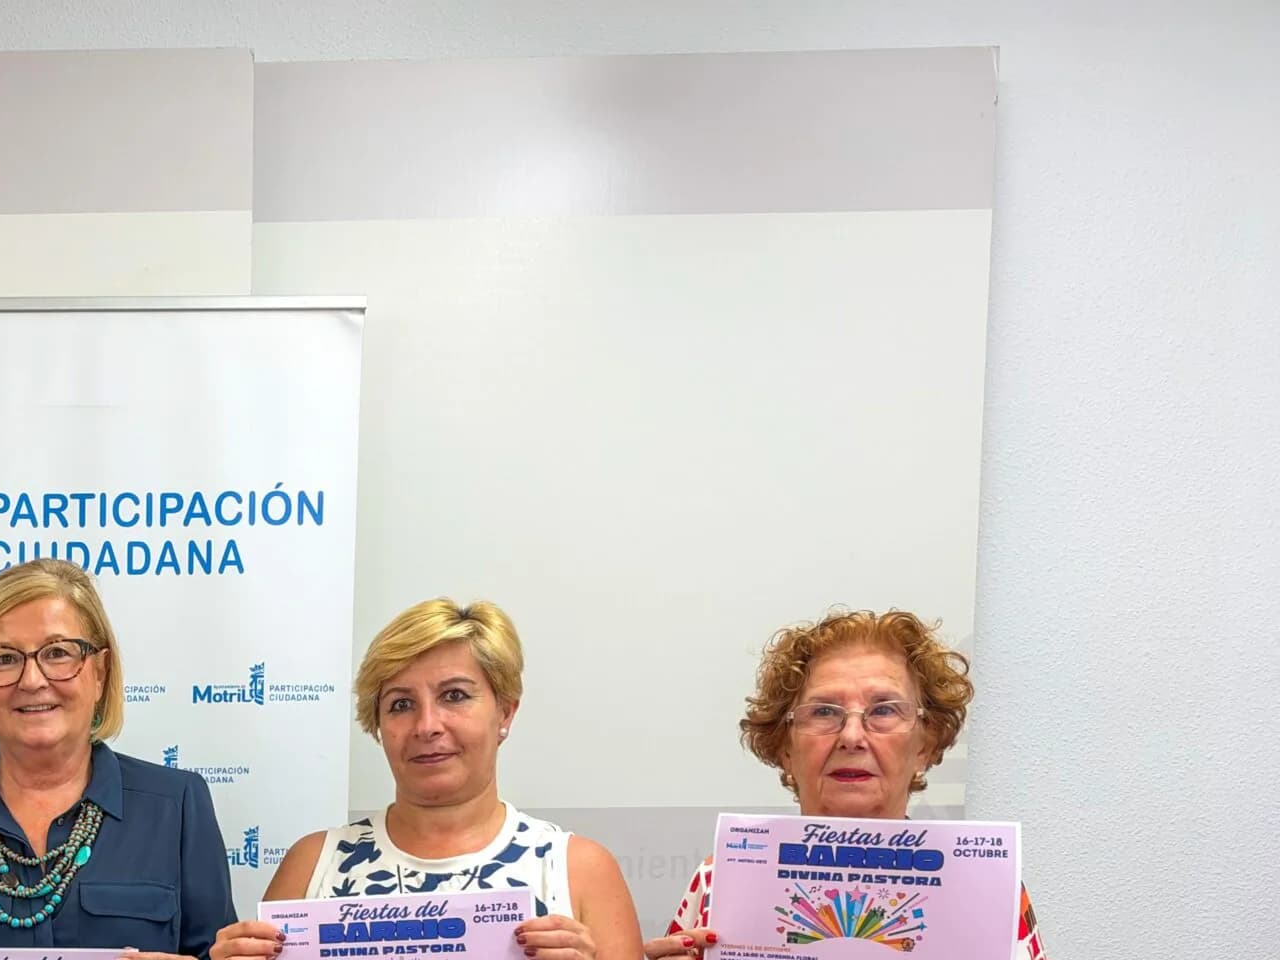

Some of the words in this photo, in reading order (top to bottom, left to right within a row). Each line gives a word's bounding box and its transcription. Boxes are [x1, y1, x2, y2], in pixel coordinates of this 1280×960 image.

[269, 684, 335, 693] PARTICIPACIÓN
[269, 694, 320, 702] CIUDADANA
[801, 824, 884, 846] Fiestas
[888, 830, 928, 847] del
[956, 837, 1002, 846] 16-17-18
[778, 843, 944, 872] BARRIO
[953, 848, 1008, 858] OCTUBRE
[777, 869, 844, 882] DIVINA
[848, 873, 941, 886] PASTORA
[339, 903, 411, 922] Fiestas
[414, 900, 448, 918] del
[475, 903, 518, 912] 16-17-18
[473, 913, 523, 923] OCTUBRE
[319, 918, 465, 944] BARRIO
[320, 947, 379, 957] DIVINA
[382, 943, 466, 955] PASTORA
